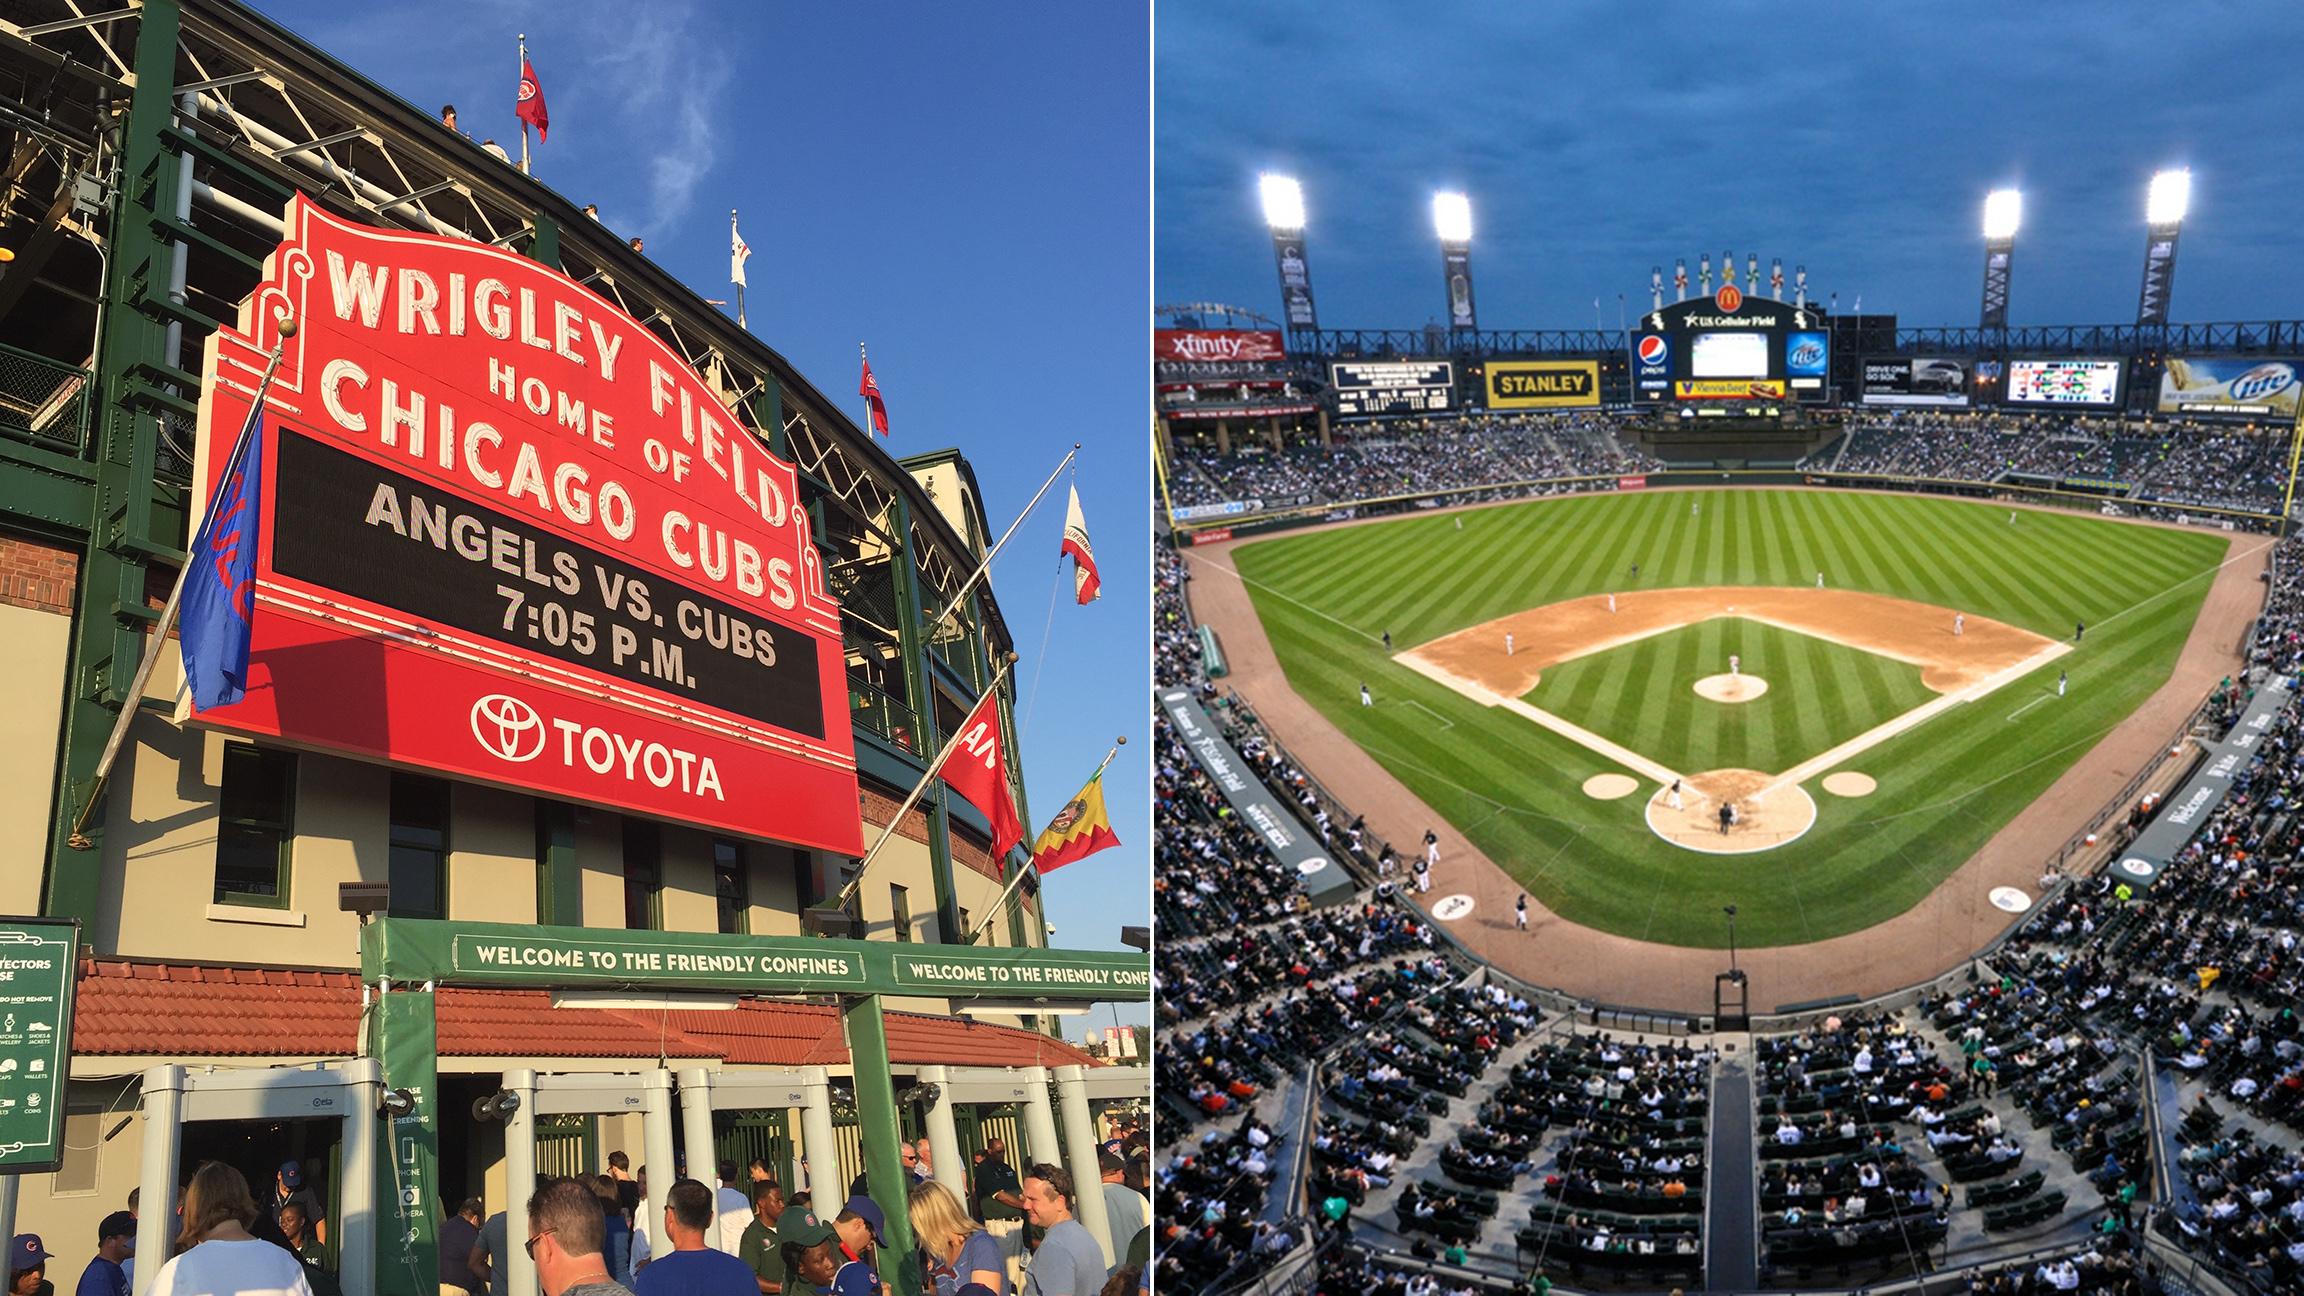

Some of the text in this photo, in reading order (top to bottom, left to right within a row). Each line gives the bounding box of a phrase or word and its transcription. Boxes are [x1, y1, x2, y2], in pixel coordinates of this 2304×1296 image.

[1715, 315, 1750, 327] Cellular
[1751, 315, 1776, 327] Field
[1172, 333, 1242, 360] xfinity
[1501, 375, 1585, 393] STANLEY
[1641, 366, 1667, 376] pepsi
[1865, 373, 1878, 381] GO
[326, 248, 788, 530] WRIGLEY FIELD
[1696, 382, 1727, 392] Vienna
[1727, 382, 1748, 393] Beef
[488, 357, 692, 483] HOME OF
[320, 358, 799, 611] CHICAGO CUBS
[364, 482, 777, 669] ANGELS VS. CUBS
[495, 585, 698, 688] 7:05 P.M.
[554, 719, 725, 802] TOYOTA
[2168, 713, 2271, 825] Welcome White Sox Fans
[476, 945, 849, 975] WELCOME TO THE FRIENDLY CONFINES
[910, 963, 987, 982] WELCOME
[989, 966, 1009, 982] TO
[1012, 967, 1042, 982] THE
[1045, 968, 1109, 984] FRIENDLY
[394, 1209, 424, 1218] CMERA
